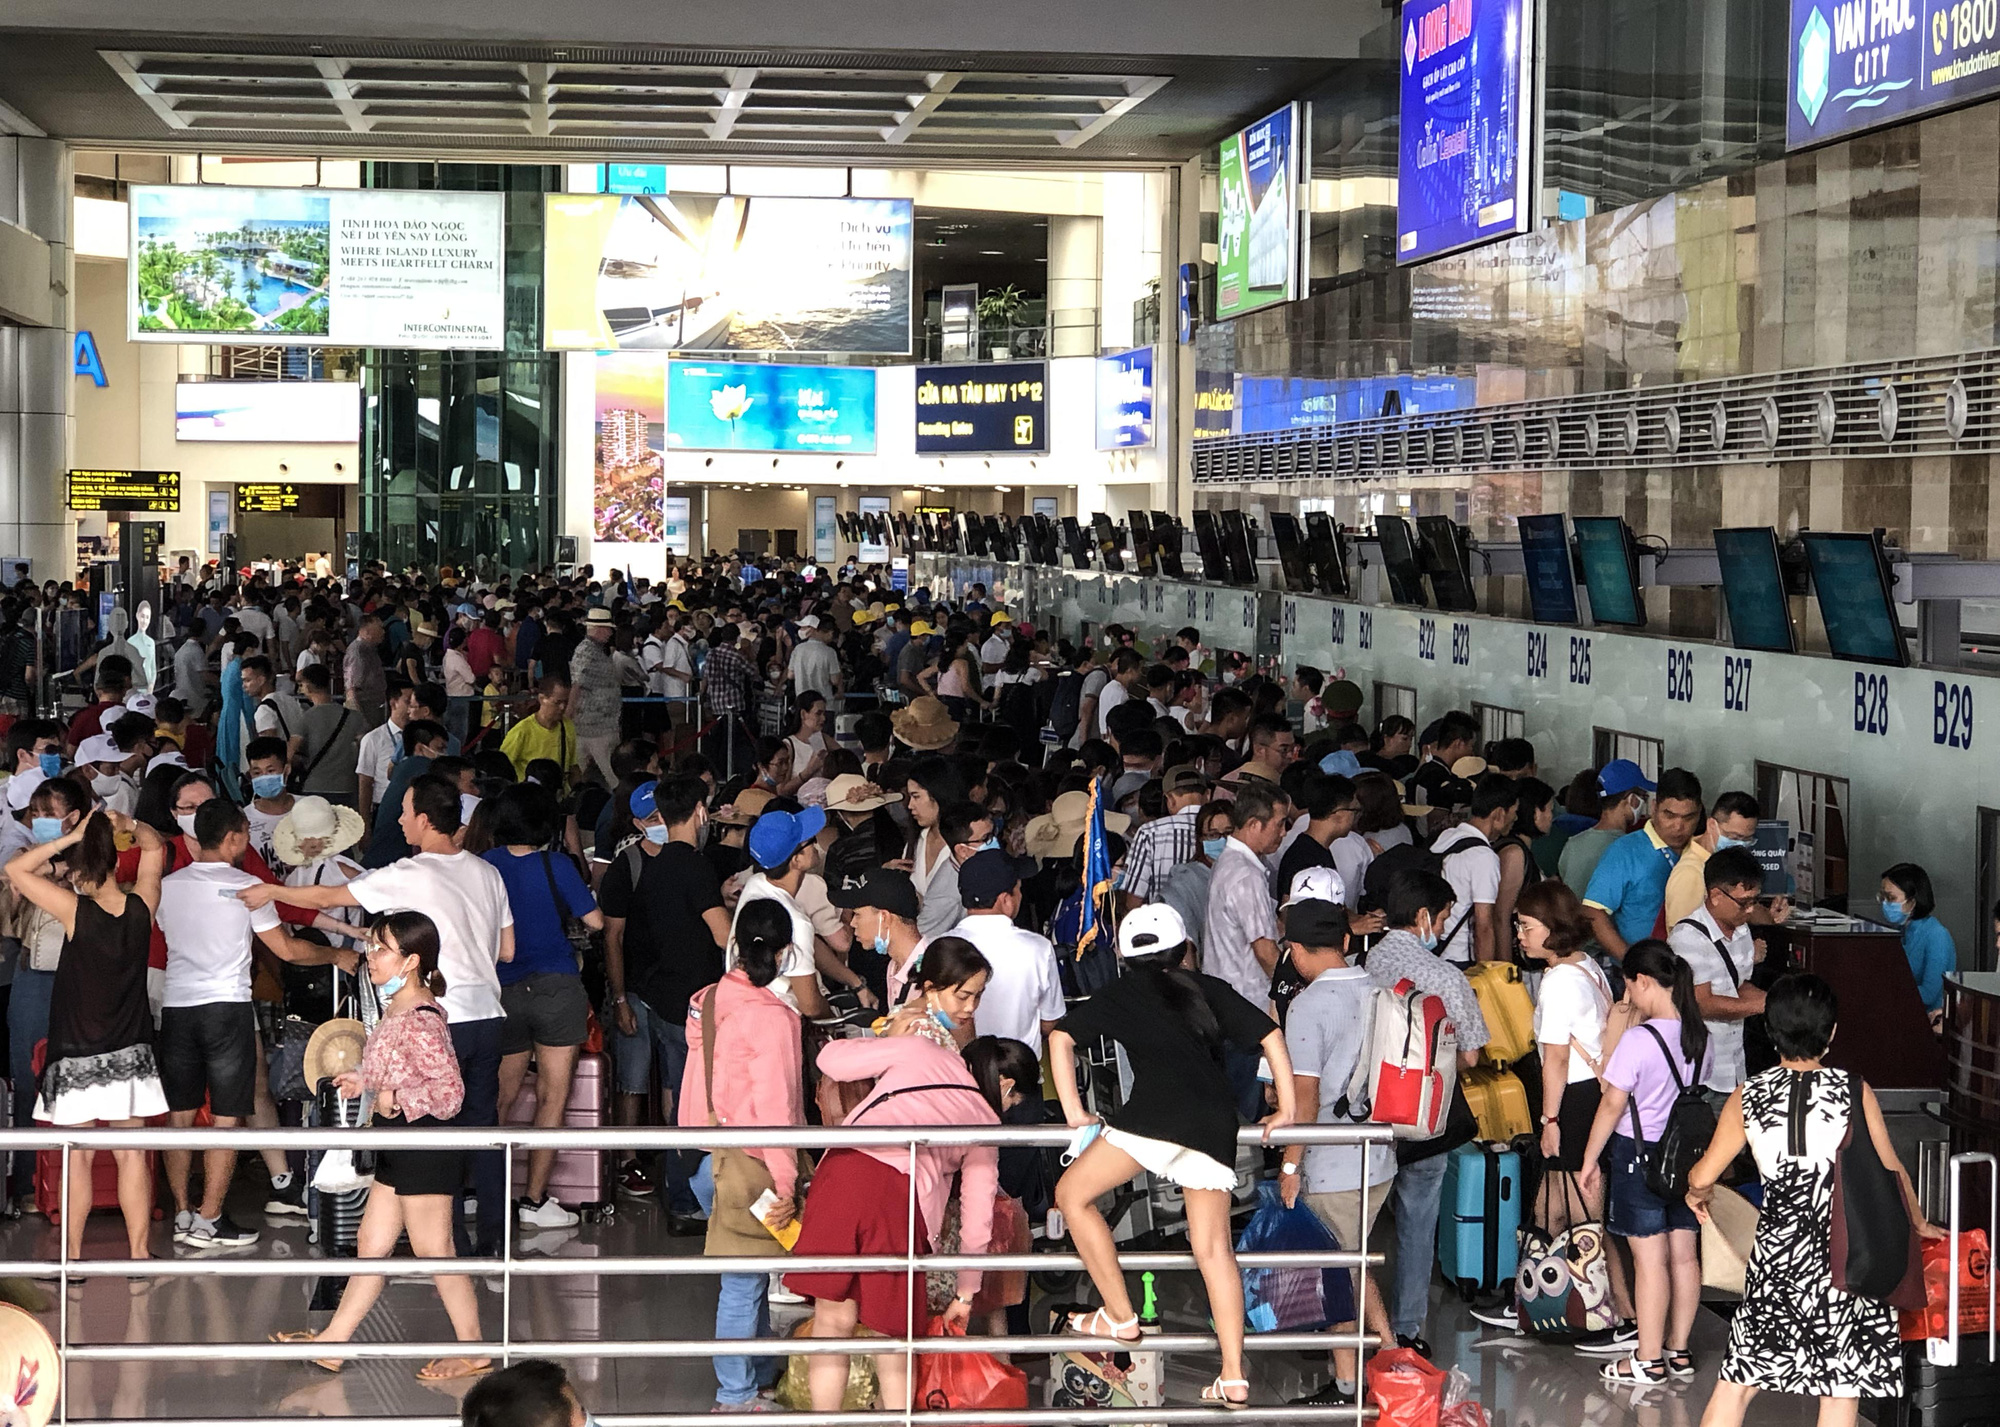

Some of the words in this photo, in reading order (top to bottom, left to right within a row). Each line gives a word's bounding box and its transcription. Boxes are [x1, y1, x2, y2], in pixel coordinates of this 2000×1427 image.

[1418, 4, 1448, 62] LONG
[1950, 0, 1997, 50] 1800
[1854, 44, 1890, 85] CITY
[340, 246, 382, 256] WHERE
[386, 247, 428, 257] ISLAND
[431, 248, 478, 258] LUXURY
[410, 232, 431, 241] SAY
[875, 225, 891, 236] vụ
[340, 257, 378, 267] MEETS
[381, 258, 448, 269] HEARTFELT
[450, 260, 494, 270] CHARM
[75, 331, 108, 387] A
[1332, 607, 1345, 645] B20
[1359, 611, 1373, 650] B21
[1419, 618, 1435, 661] B22
[1452, 622, 1470, 666] B23
[1526, 631, 1548, 679] B24
[1569, 636, 1591, 686] B25
[1667, 648, 1693, 703] B26
[1724, 655, 1752, 713] B27
[1854, 671, 1889, 737] B28
[1934, 680, 1973, 751] B29
